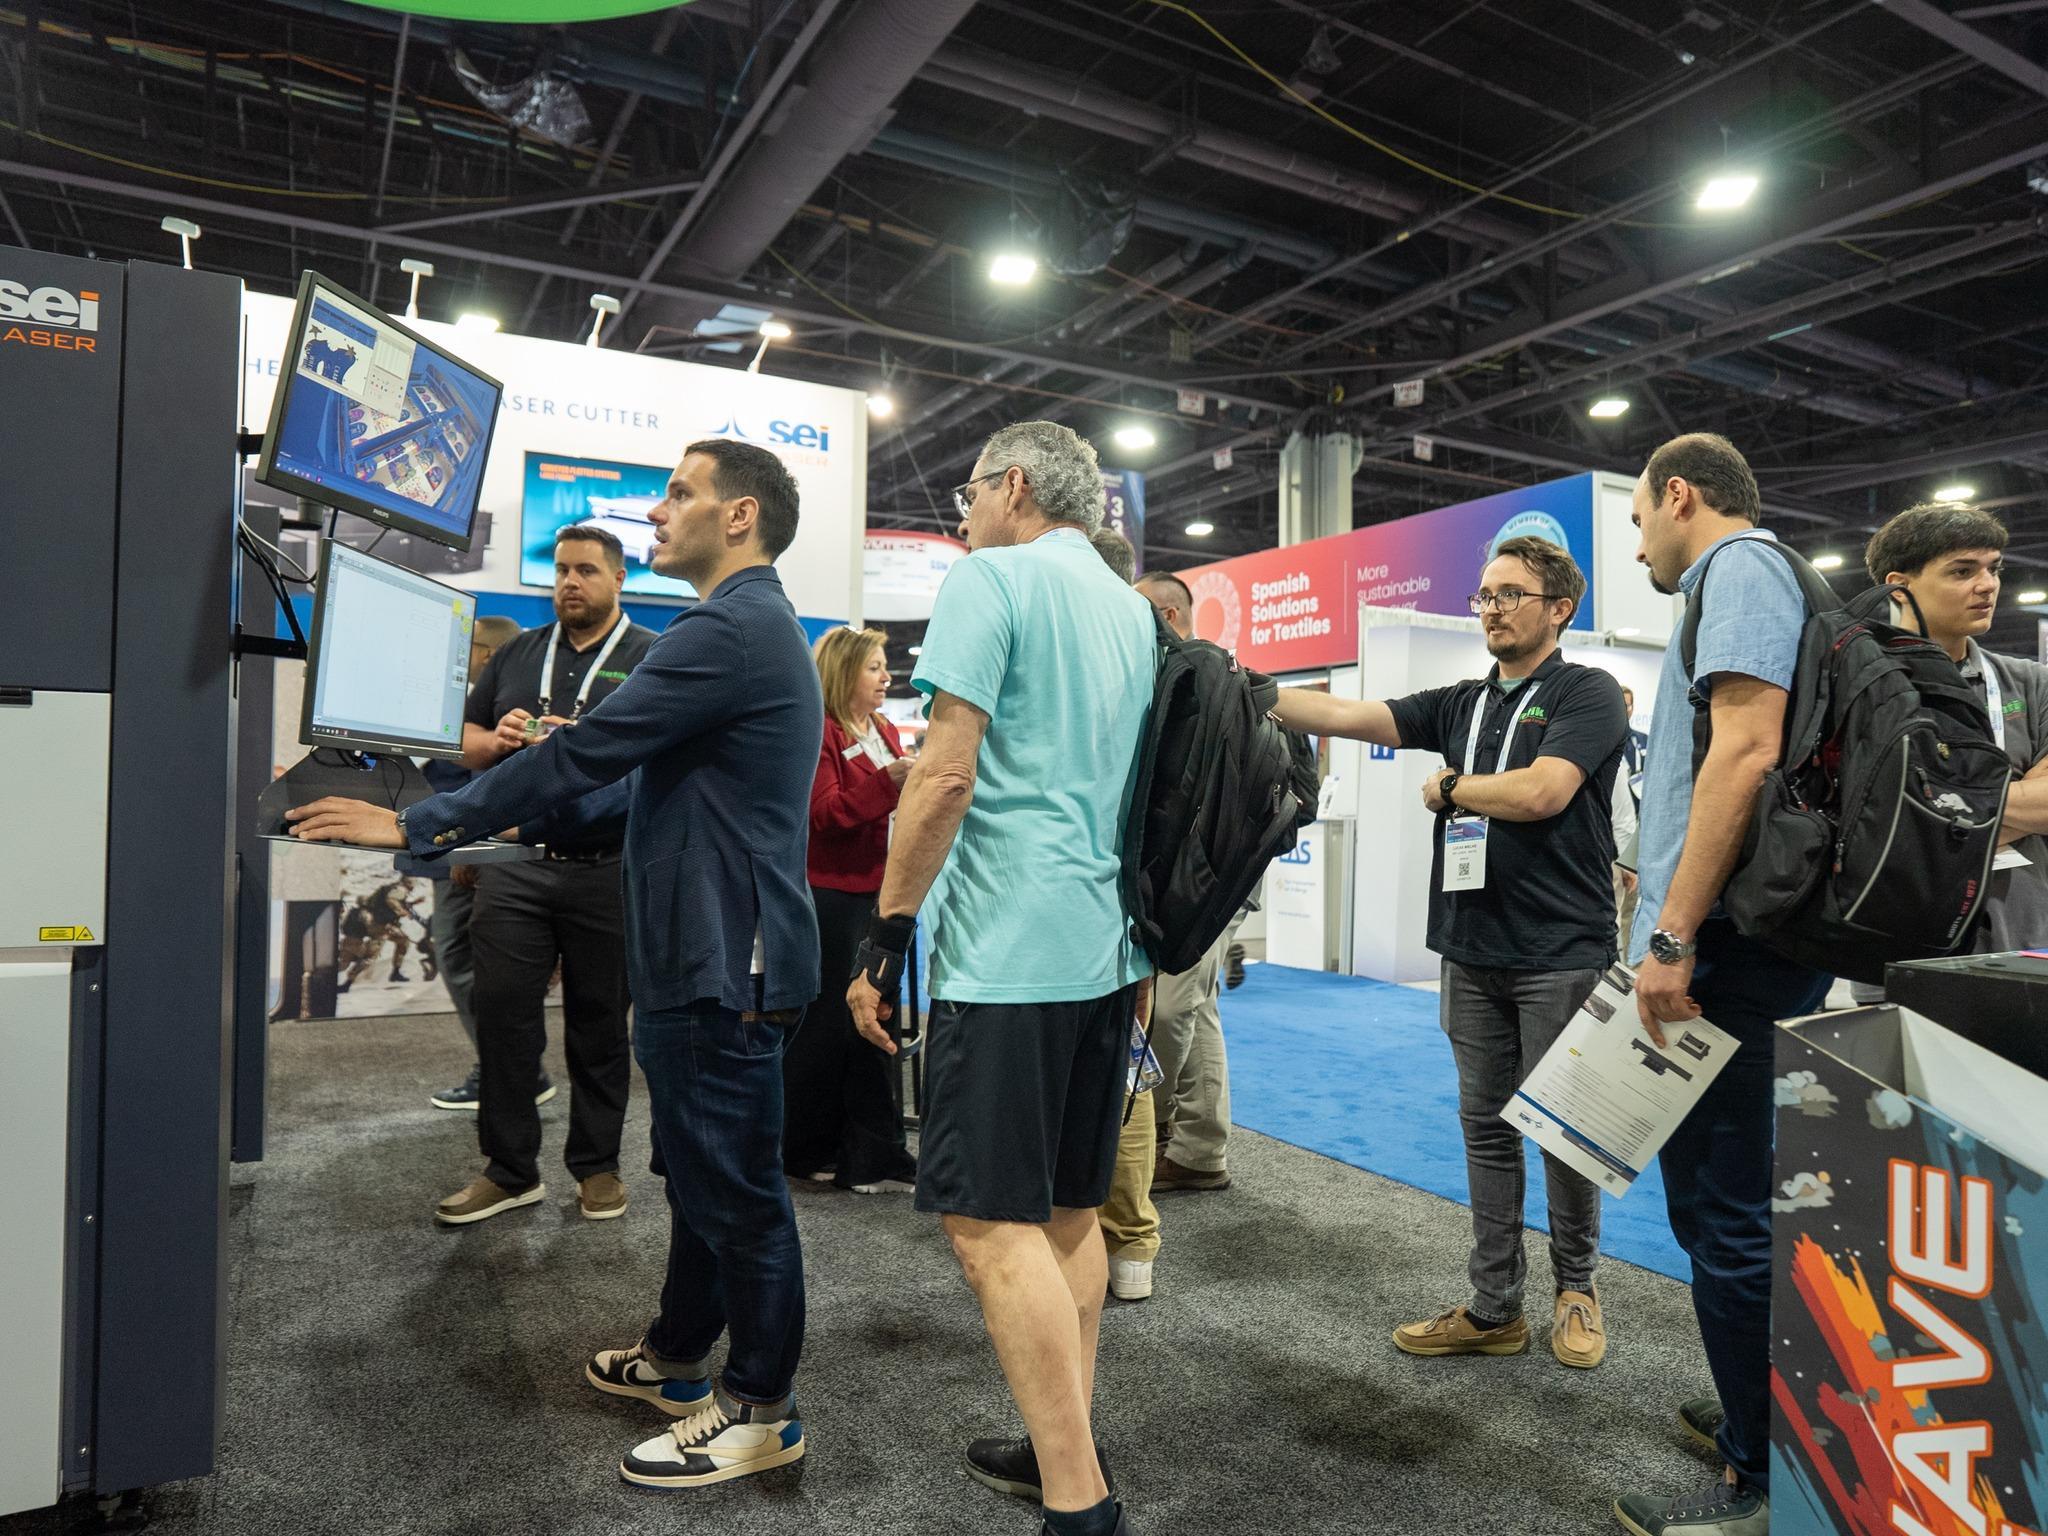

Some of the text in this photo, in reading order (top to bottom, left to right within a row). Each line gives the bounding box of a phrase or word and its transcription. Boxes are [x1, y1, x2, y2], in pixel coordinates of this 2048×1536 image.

[0, 280, 99, 331] sei
[2, 327, 97, 353] ASER
[567, 403, 659, 429] CUTTER
[768, 419, 829, 452] sei
[1110, 495, 1124, 518] 3
[1357, 564, 1389, 583] More
[1251, 572, 1310, 605] Spanish
[1357, 576, 1431, 602] sustainable
[1251, 596, 1319, 624] Solutions
[1251, 617, 1331, 646] for Textiles
[1887, 1157, 1994, 1536] AVE
